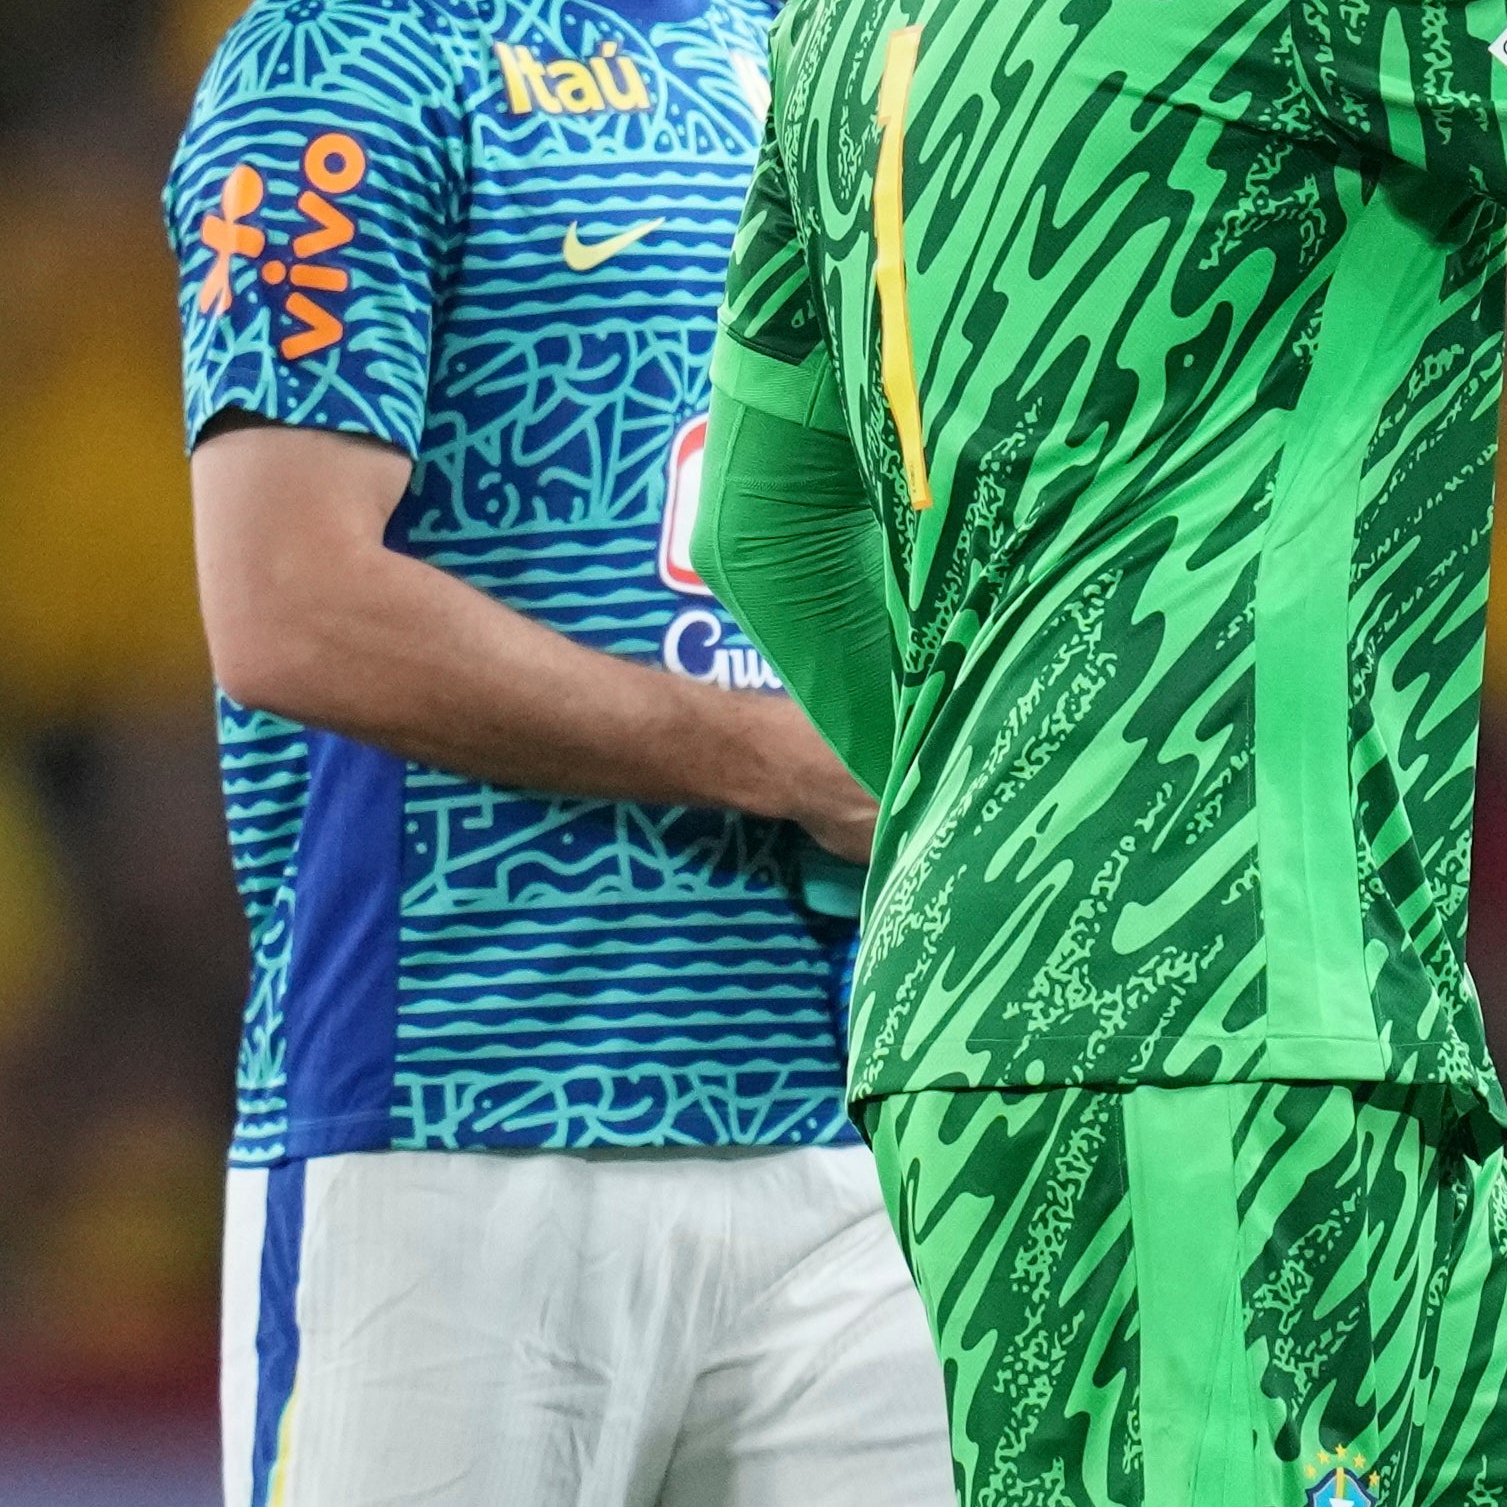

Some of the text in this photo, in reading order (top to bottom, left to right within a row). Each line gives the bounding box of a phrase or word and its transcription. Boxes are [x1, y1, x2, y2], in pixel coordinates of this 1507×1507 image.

[494, 41, 651, 115] Itaú
[262, 132, 366, 361] vivo
[874, 24, 932, 510] 1
